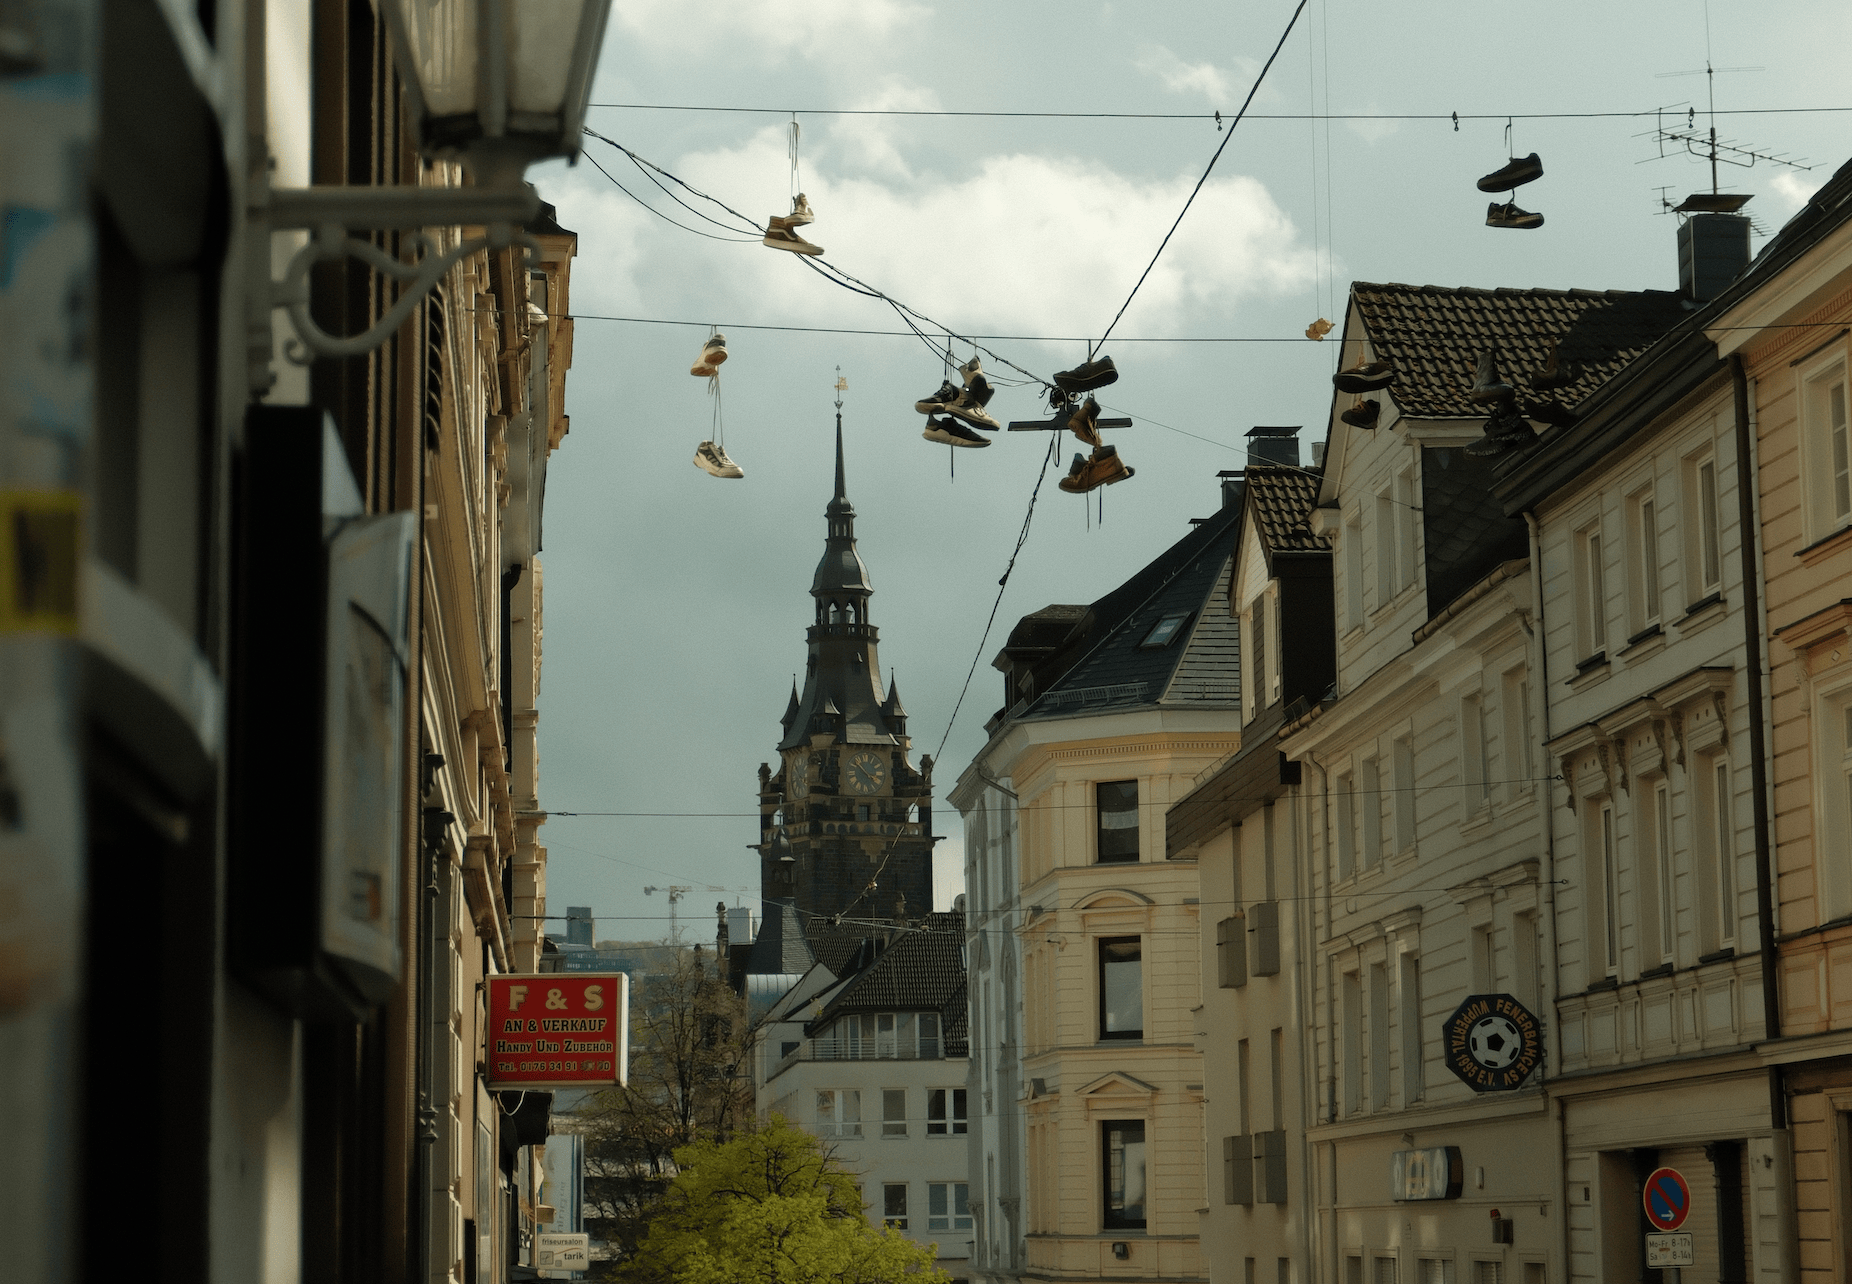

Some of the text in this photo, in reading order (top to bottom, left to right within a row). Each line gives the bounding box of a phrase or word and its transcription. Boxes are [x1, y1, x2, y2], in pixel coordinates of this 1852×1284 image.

[509, 984, 604, 1011] F & S
[504, 1018, 606, 1033] AN & VERKAUF
[1452, 1000, 1495, 1086] WUPPERTAL 1995 E.V.
[520, 1061, 546, 1071] 0176
[549, 1061, 562, 1071] 34
[565, 1061, 577, 1071] 91
[1503, 1069, 1519, 1086] SV
[1649, 1240, 1668, 1248] Mo-Fr
[564, 1252, 584, 1260] tarik
